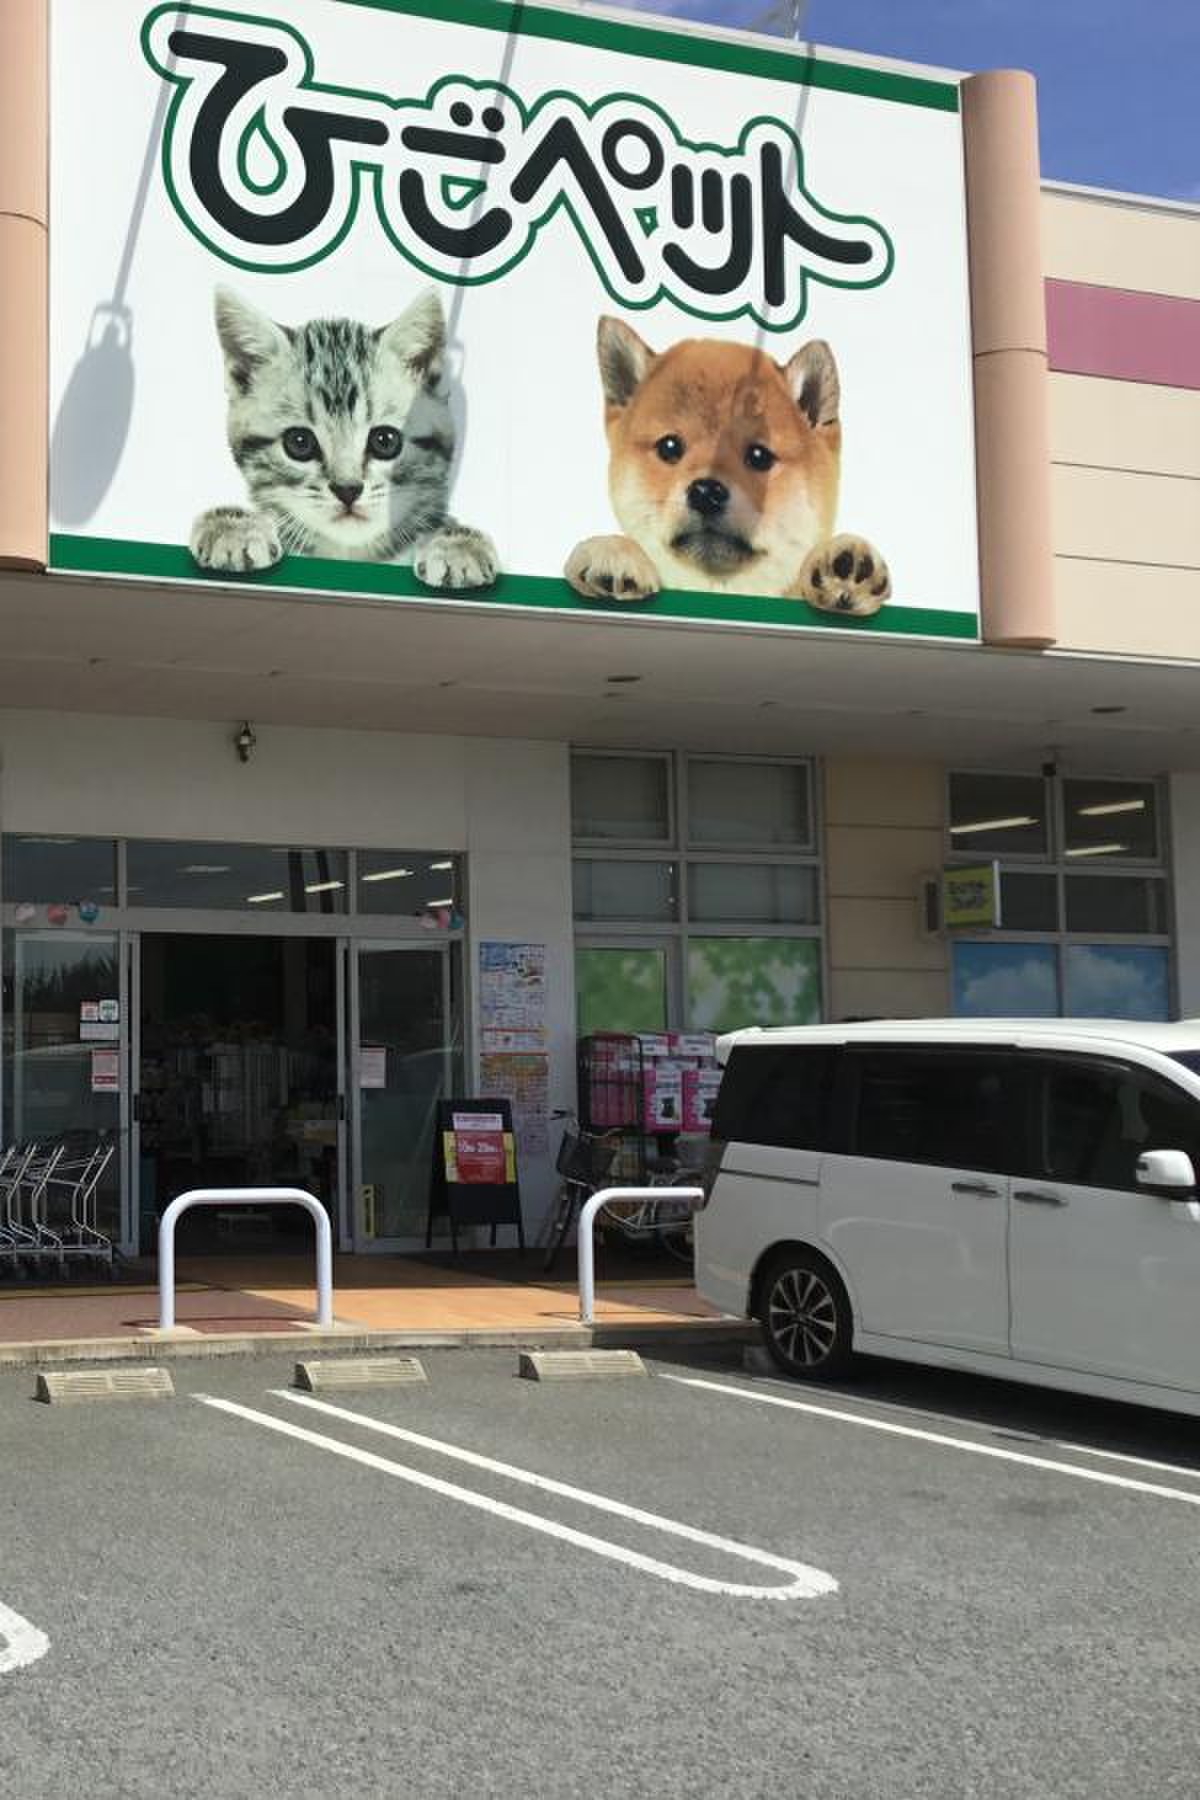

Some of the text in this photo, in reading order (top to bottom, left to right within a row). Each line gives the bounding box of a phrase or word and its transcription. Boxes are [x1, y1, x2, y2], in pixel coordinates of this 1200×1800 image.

[166, 29, 875, 306] ひごペット
